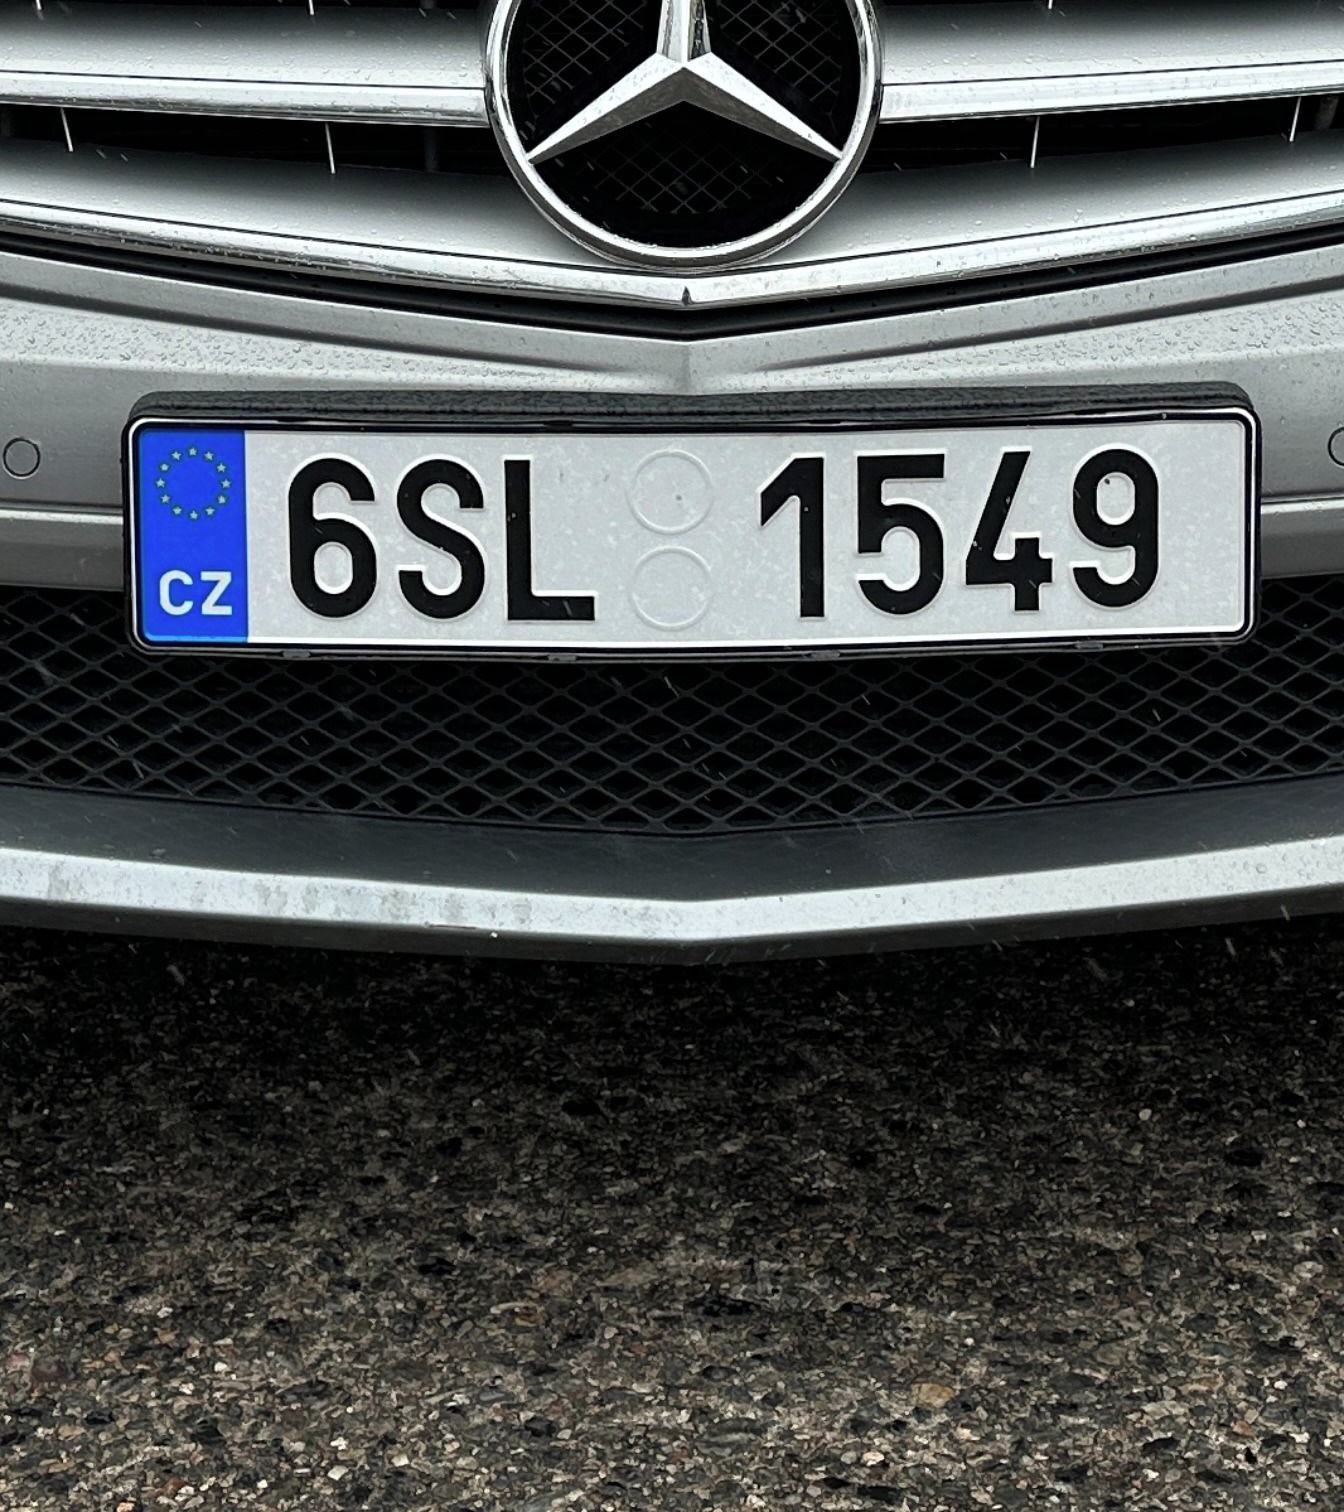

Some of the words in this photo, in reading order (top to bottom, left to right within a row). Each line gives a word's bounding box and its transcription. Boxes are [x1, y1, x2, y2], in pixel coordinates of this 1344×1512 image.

[288, 457, 597, 622] 6SL
[760, 451, 1160, 618] 1549
[158, 569, 233, 616] CZ
